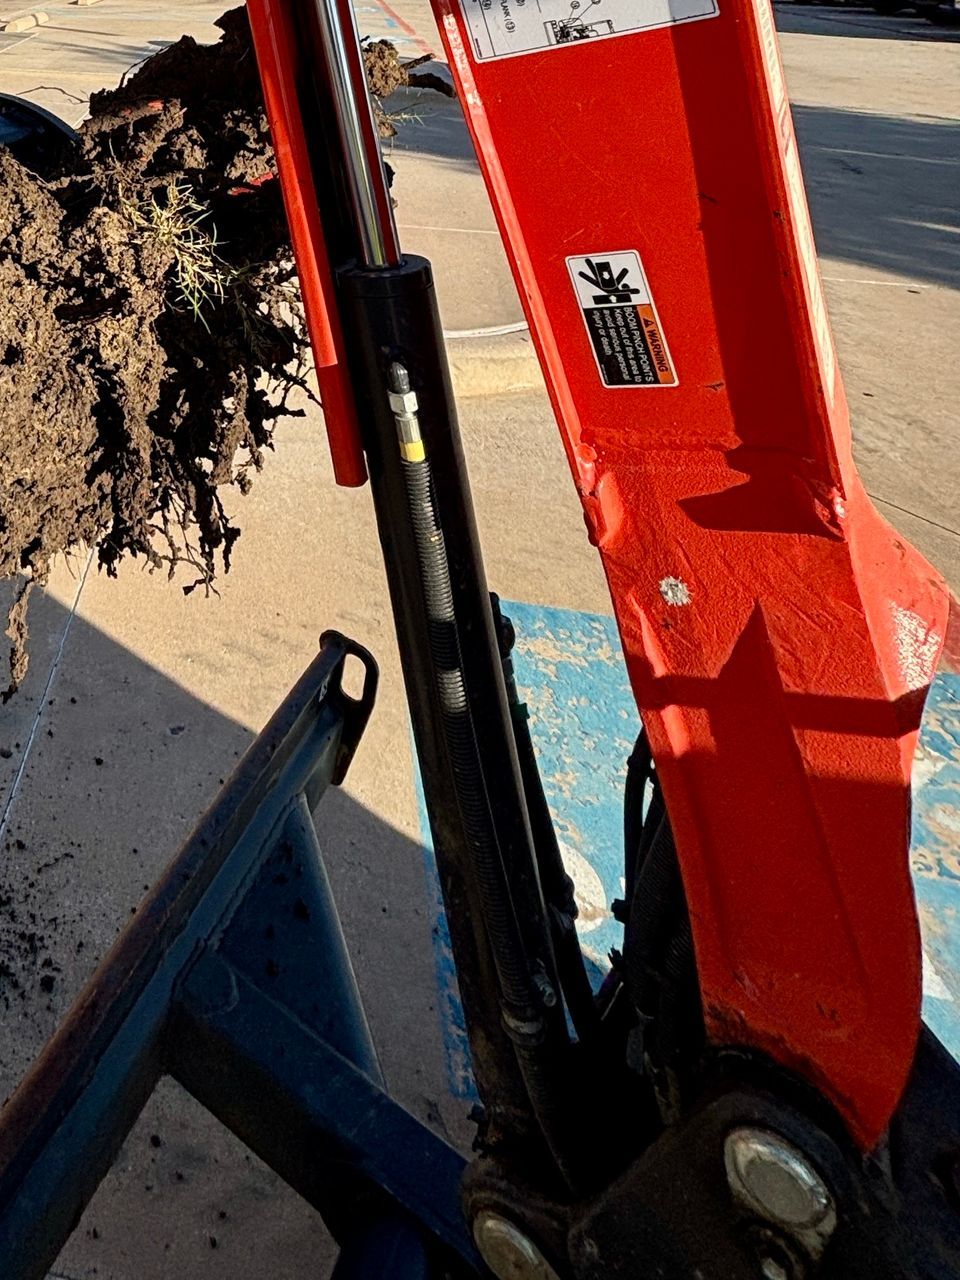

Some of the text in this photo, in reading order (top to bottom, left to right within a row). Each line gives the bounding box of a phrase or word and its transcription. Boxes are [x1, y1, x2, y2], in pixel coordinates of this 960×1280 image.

[592, 310, 603, 327] injury
[614, 308, 624, 326] Keep
[620, 328, 629, 338] out
[603, 309, 631, 380] avoid serious personal
[623, 339, 632, 347] of
[623, 307, 654, 382] BOOM PINCH POINTS
[647, 329, 668, 372] WARNING
[625, 347, 634, 359] this
[629, 360, 639, 375] area
